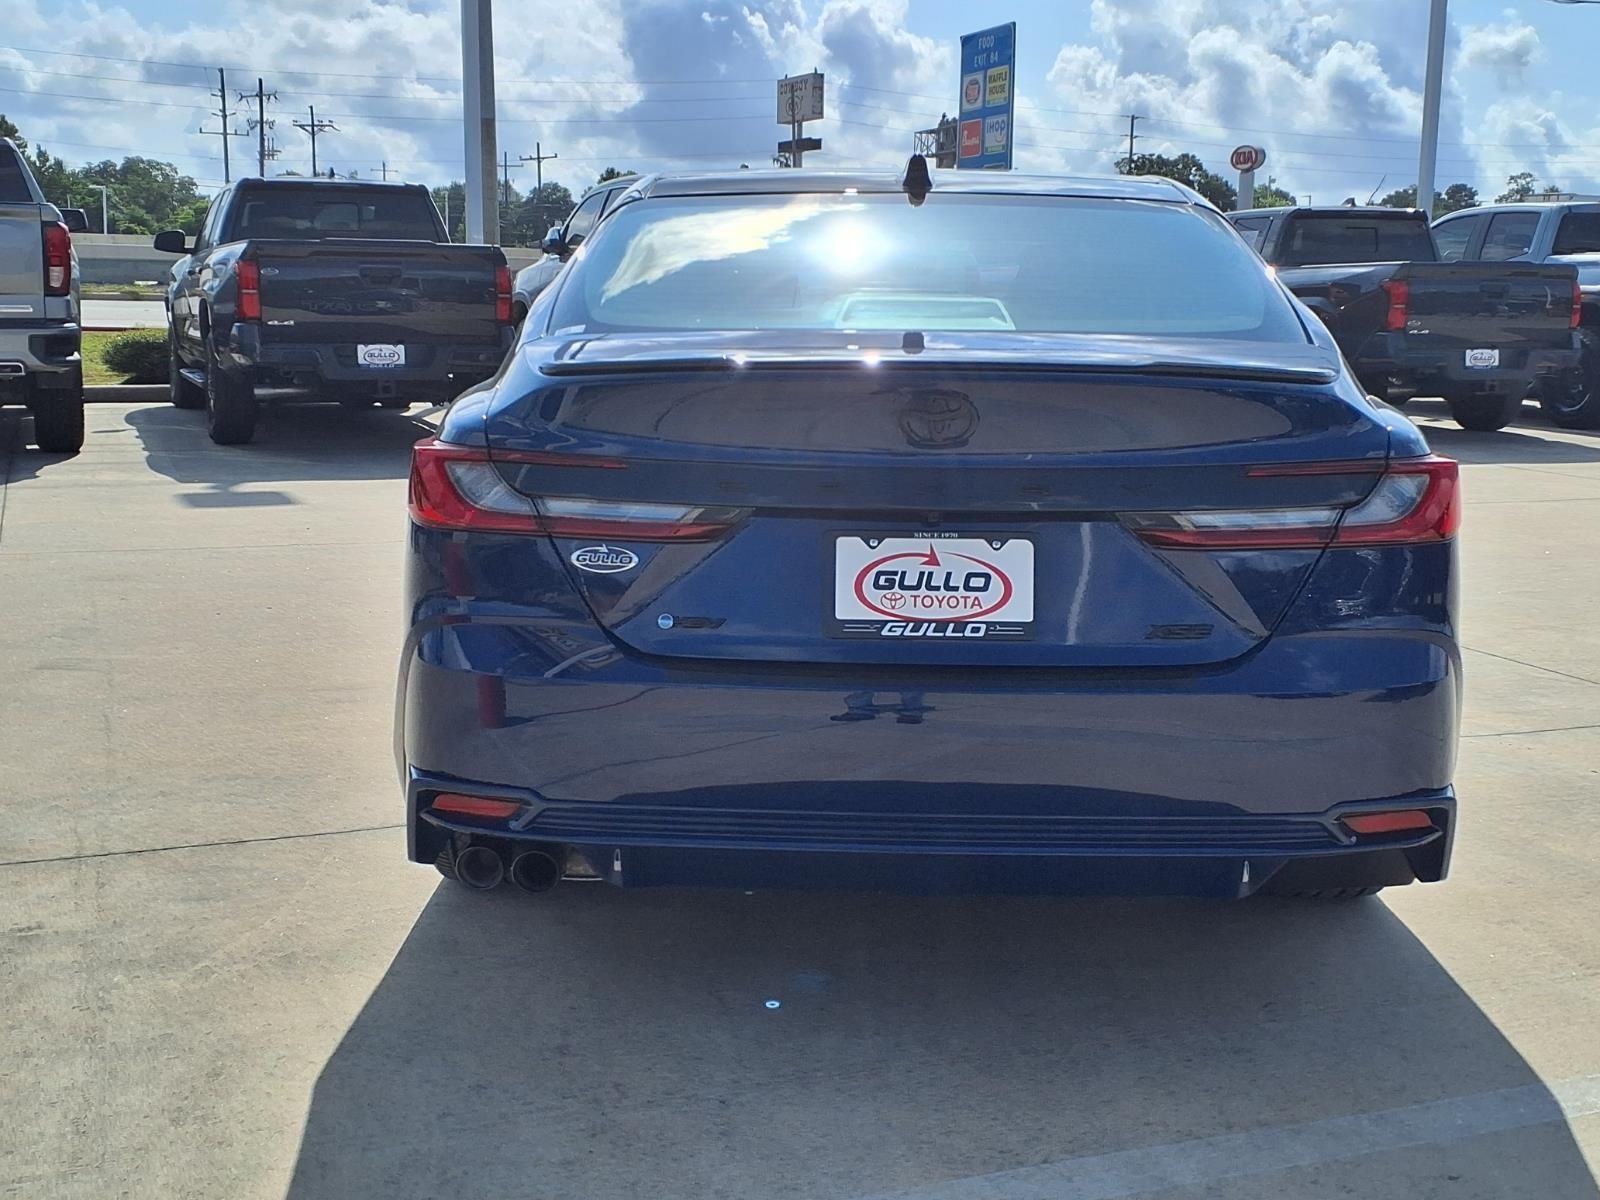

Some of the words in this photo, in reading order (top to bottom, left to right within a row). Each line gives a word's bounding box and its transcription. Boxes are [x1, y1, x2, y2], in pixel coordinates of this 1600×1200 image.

[978, 35, 995, 49] FOOD
[974, 53, 987, 67] EXIT
[988, 71, 1008, 84] WAFFLE
[988, 83, 1006, 96] HOUSE
[1235, 150, 1255, 165] KIA
[575, 552, 634, 566] GULLO
[872, 570, 992, 593] GULLO
[910, 594, 983, 610] TOYOTA
[880, 622, 987, 637] GULLO
